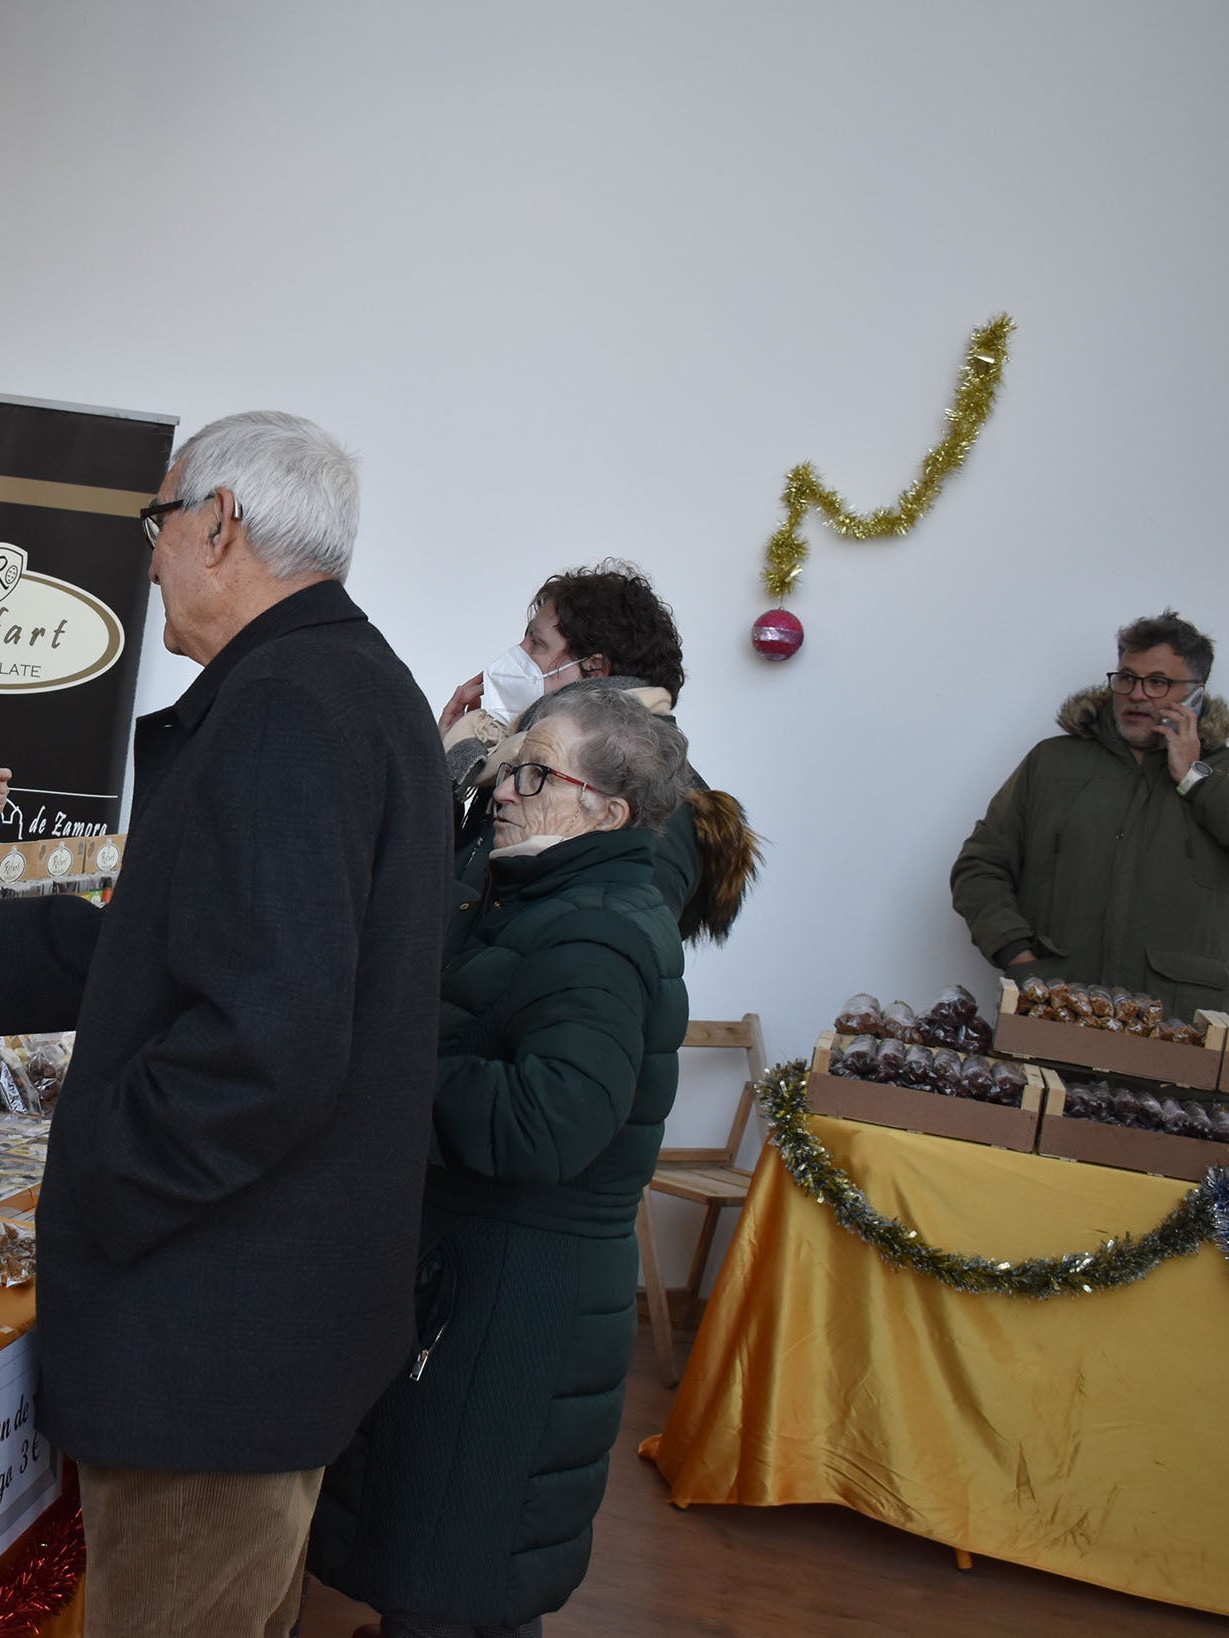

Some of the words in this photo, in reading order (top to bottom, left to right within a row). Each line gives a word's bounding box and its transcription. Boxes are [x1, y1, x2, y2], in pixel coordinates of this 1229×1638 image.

[29, 805, 47, 834] de
[51, 811, 108, 837] Zamora
[14, 1394, 29, 1431] de
